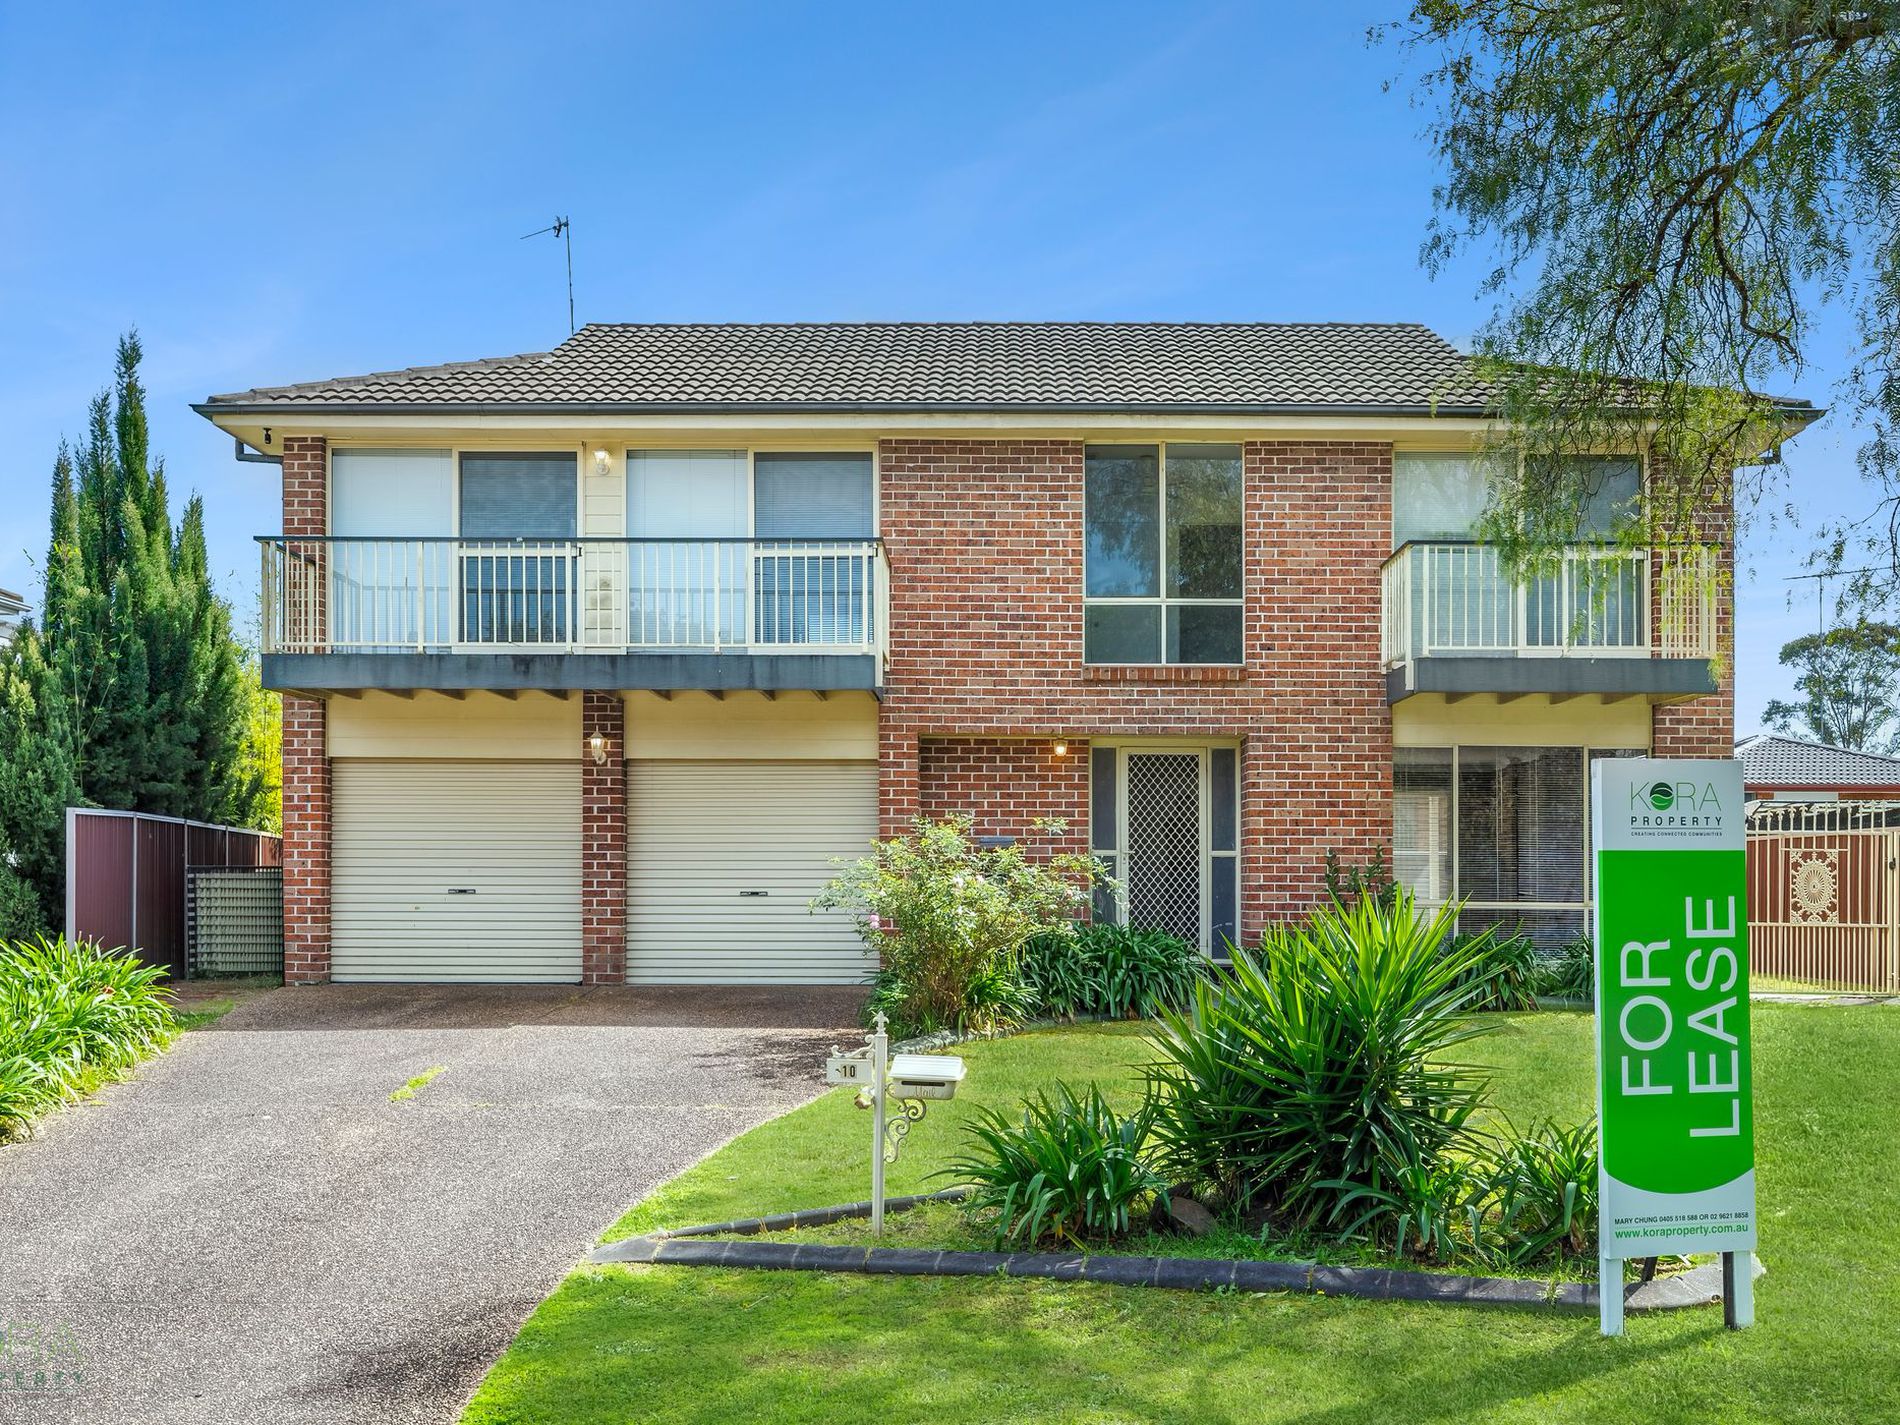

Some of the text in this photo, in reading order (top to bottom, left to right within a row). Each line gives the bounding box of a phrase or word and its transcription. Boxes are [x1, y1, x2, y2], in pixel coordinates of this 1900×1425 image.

[1630, 781, 1722, 812] KORA
[1630, 816, 1722, 826] PROPERTY
[1619, 938, 1673, 1097] FOR
[1685, 895, 1741, 1138] LEASE
[1614, 1217, 1633, 1225] MARY
[1634, 1216, 1658, 1224] CHUNG
[1614, 1224, 1749, 1239] www.koraproperty.com.au
